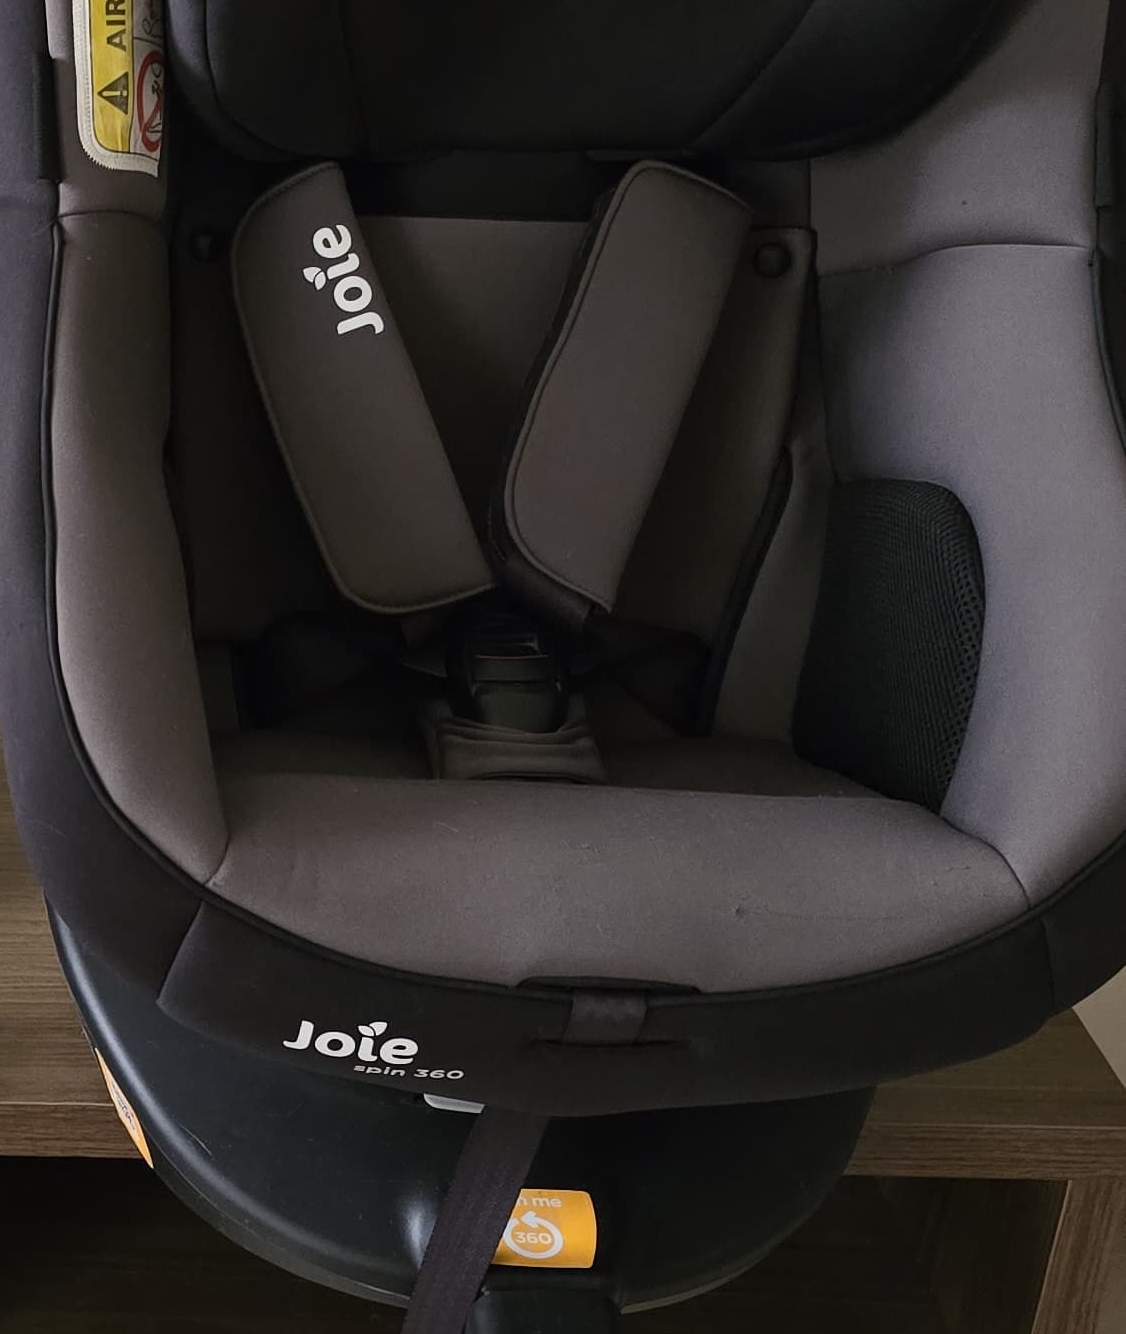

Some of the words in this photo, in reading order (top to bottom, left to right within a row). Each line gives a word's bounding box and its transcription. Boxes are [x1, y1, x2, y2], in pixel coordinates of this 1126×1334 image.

[302, 224, 384, 335] Joie
[282, 1020, 419, 1065] Joie
[353, 1065, 406, 1077] spin
[413, 1068, 465, 1080] 360
[531, 1196, 563, 1208] me
[514, 1231, 553, 1245] 360
